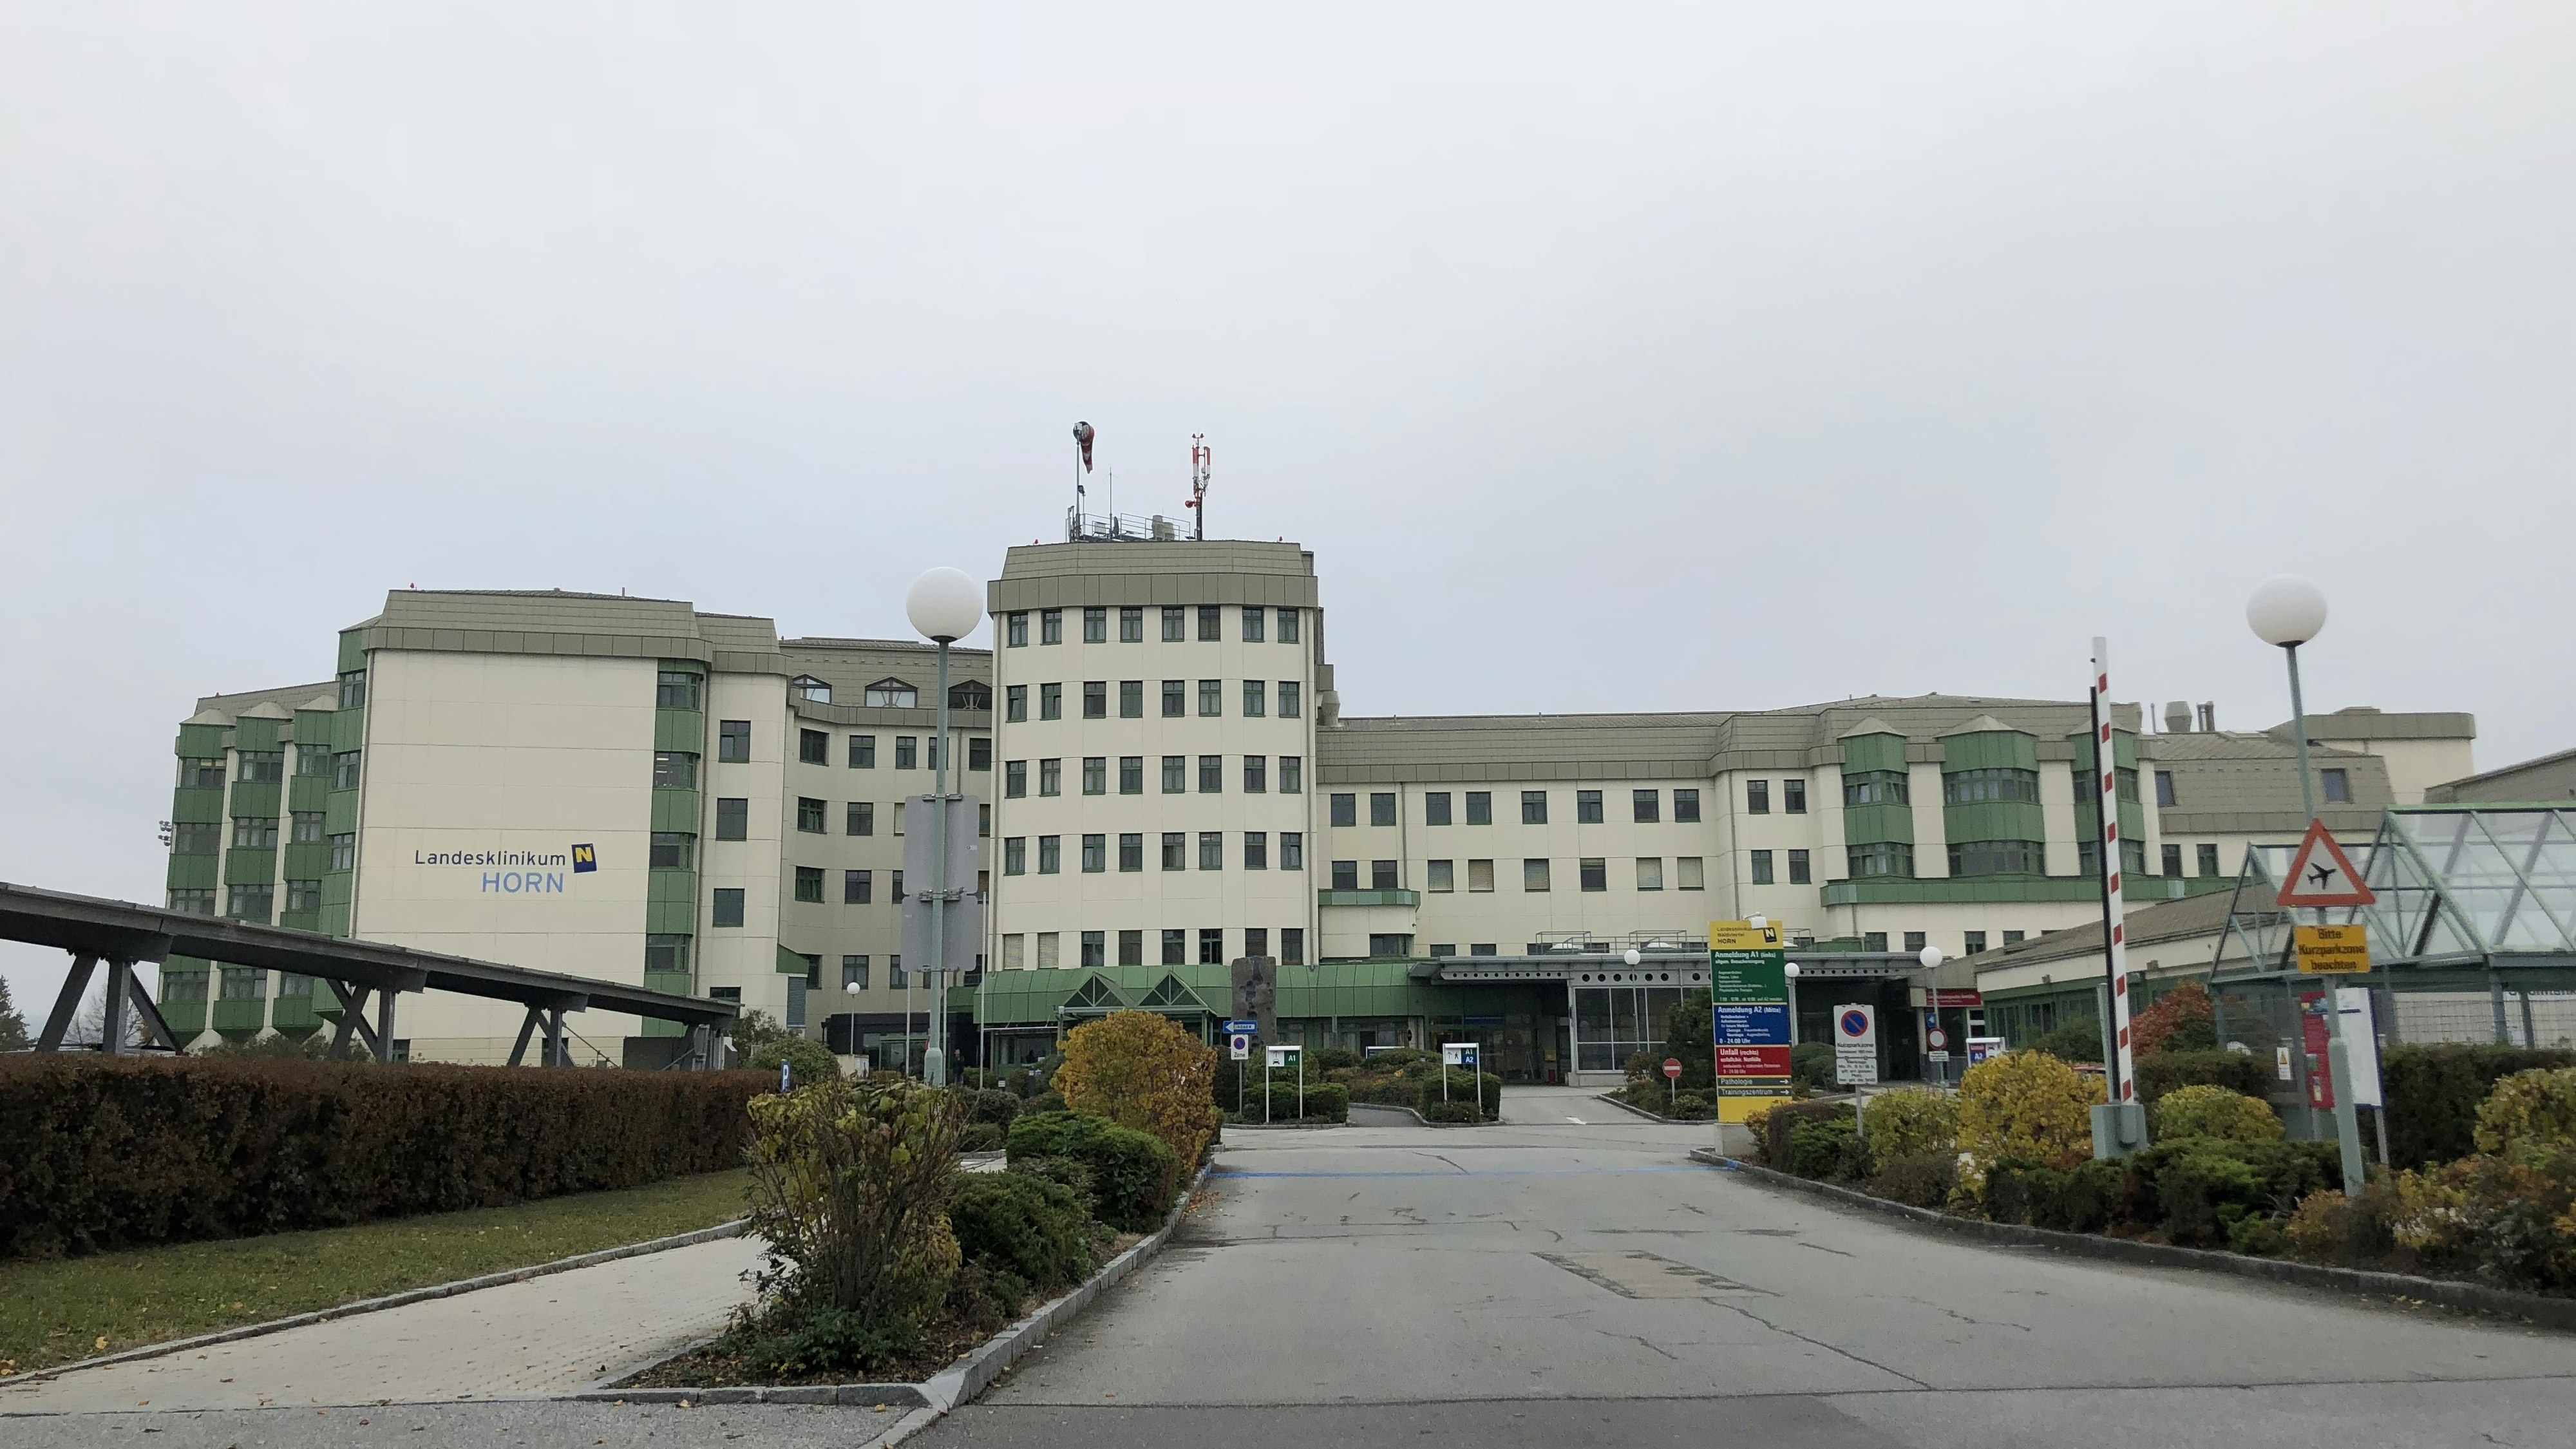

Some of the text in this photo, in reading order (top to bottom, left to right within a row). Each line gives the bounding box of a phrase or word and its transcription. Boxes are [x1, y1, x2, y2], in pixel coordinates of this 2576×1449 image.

[415, 847, 592, 866] Landesklinikum N
[482, 872, 564, 893] HORN
[1715, 951, 1749, 960] Anmeldung
[2298, 943, 2365, 957] Kurzparkzone
[2311, 959, 2357, 970] beachten
